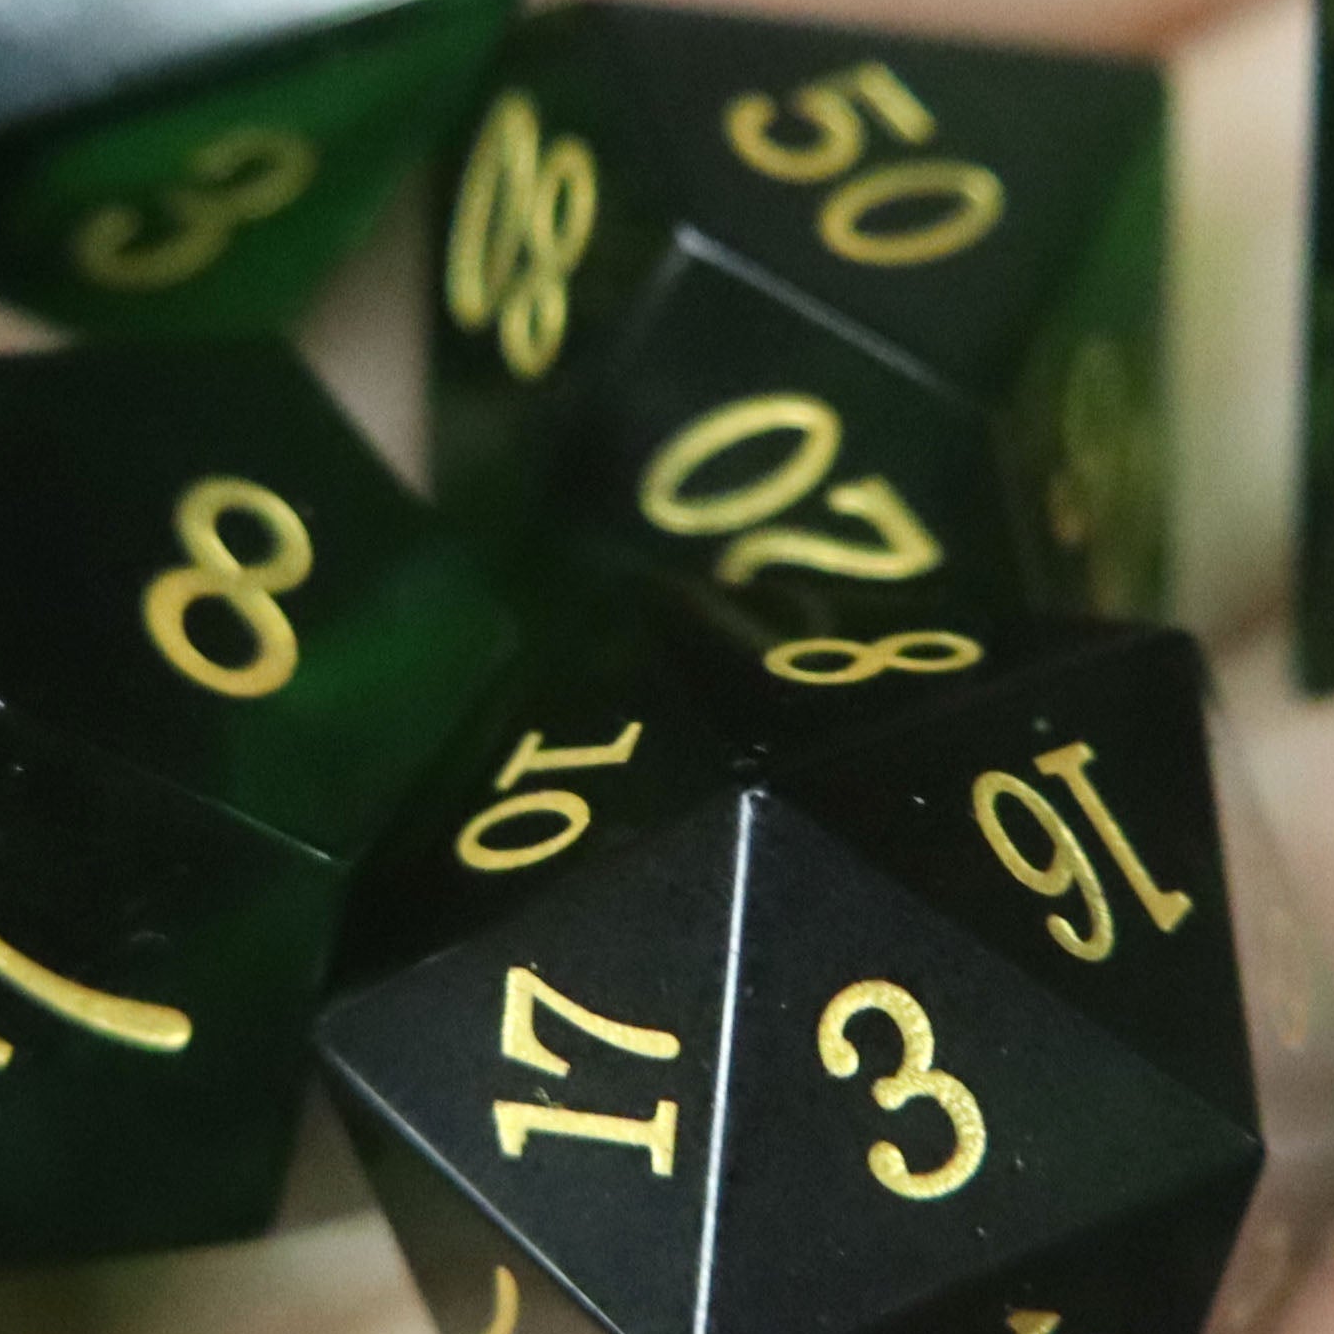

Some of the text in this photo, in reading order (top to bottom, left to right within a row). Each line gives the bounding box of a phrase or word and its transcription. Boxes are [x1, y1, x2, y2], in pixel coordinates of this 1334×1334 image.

[76, 126, 320, 292] 3
[449, 94, 598, 378] 80
[725, 63, 1003, 265] 50
[143, 479, 314, 699] 8
[764, 630, 982, 686] 8
[456, 721, 643, 871] 10
[971, 741, 1193, 961] 16
[493, 966, 682, 1175] 17
[817, 979, 987, 1198] 3
